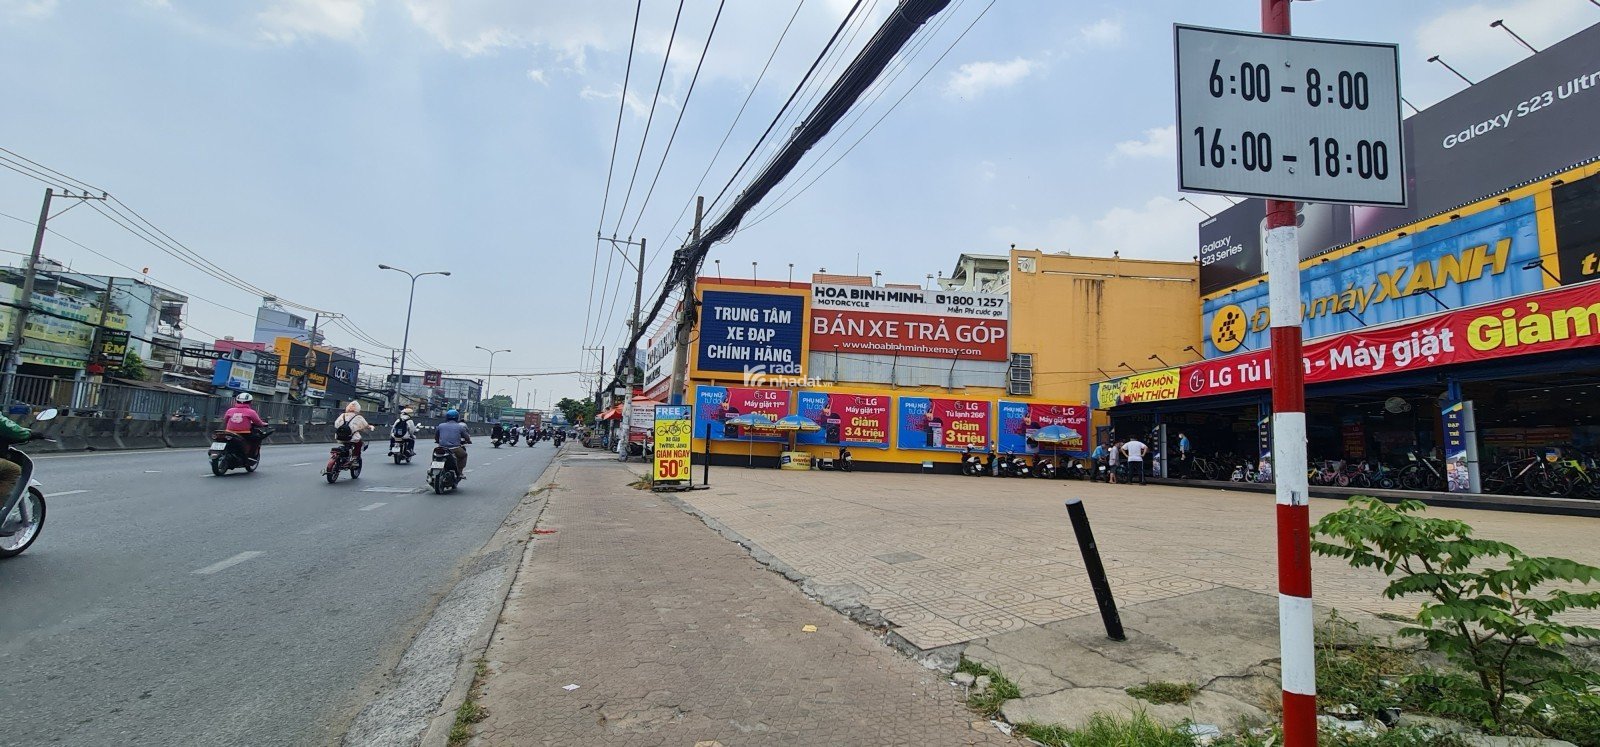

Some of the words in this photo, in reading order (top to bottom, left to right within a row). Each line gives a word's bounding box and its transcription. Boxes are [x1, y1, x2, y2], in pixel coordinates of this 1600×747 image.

[1209, 59, 1271, 103] 6:00
[1306, 68, 1369, 111] 8:00
[1442, 109, 1513, 149] Galaxy
[1516, 91, 1553, 117] S23
[1194, 126, 1272, 172] 16:00
[1309, 136, 1388, 180] 18:00
[1201, 235, 1231, 254] Galaxy
[1201, 254, 1216, 267] S23
[1216, 244, 1243, 261] Series
[814, 286, 847, 299] HOA
[818, 299, 869, 307] MOTORCYCLE
[945, 295, 974, 306] 1800
[977, 297, 1004, 307] 1257
[714, 306, 759, 323] TRUNG
[762, 307, 792, 324] TÂM
[726, 326, 744, 341] XE
[748, 328, 776, 344] ĐẠP
[813, 313, 864, 337] BÁN
[867, 319, 899, 339] XE
[903, 318, 950, 341] TRẢ
[955, 321, 1005, 344] GÓP
[1209, 366, 1231, 388] LG
[1237, 359, 1261, 383] Tủ
[1329, 340, 1386, 371] Máy
[1392, 326, 1455, 367] giặt
[1467, 302, 1600, 351] Giảm
[707, 342, 750, 360] CHÍNH
[754, 345, 792, 362] HÃNG
[1152, 374, 1174, 388] MÓN
[765, 392, 777, 400] LG
[1146, 386, 1176, 400] THÍCH
[744, 400, 758, 408] Máy
[865, 398, 877, 406] LG
[966, 402, 978, 410] LG
[655, 407, 681, 415] FREE
[845, 406, 860, 414] Máy
[860, 407, 873, 415] giặt
[954, 411, 970, 419] lạnh
[1062, 407, 1075, 415] LG
[851, 416, 879, 427] Giảm
[951, 419, 979, 431] Giảm
[844, 426, 861, 437] 3.4
[862, 427, 885, 439] triệu
[945, 429, 955, 442] 3
[956, 431, 985, 446] triệu
[673, 449, 690, 458] NGAY
[659, 459, 689, 478] 50%
